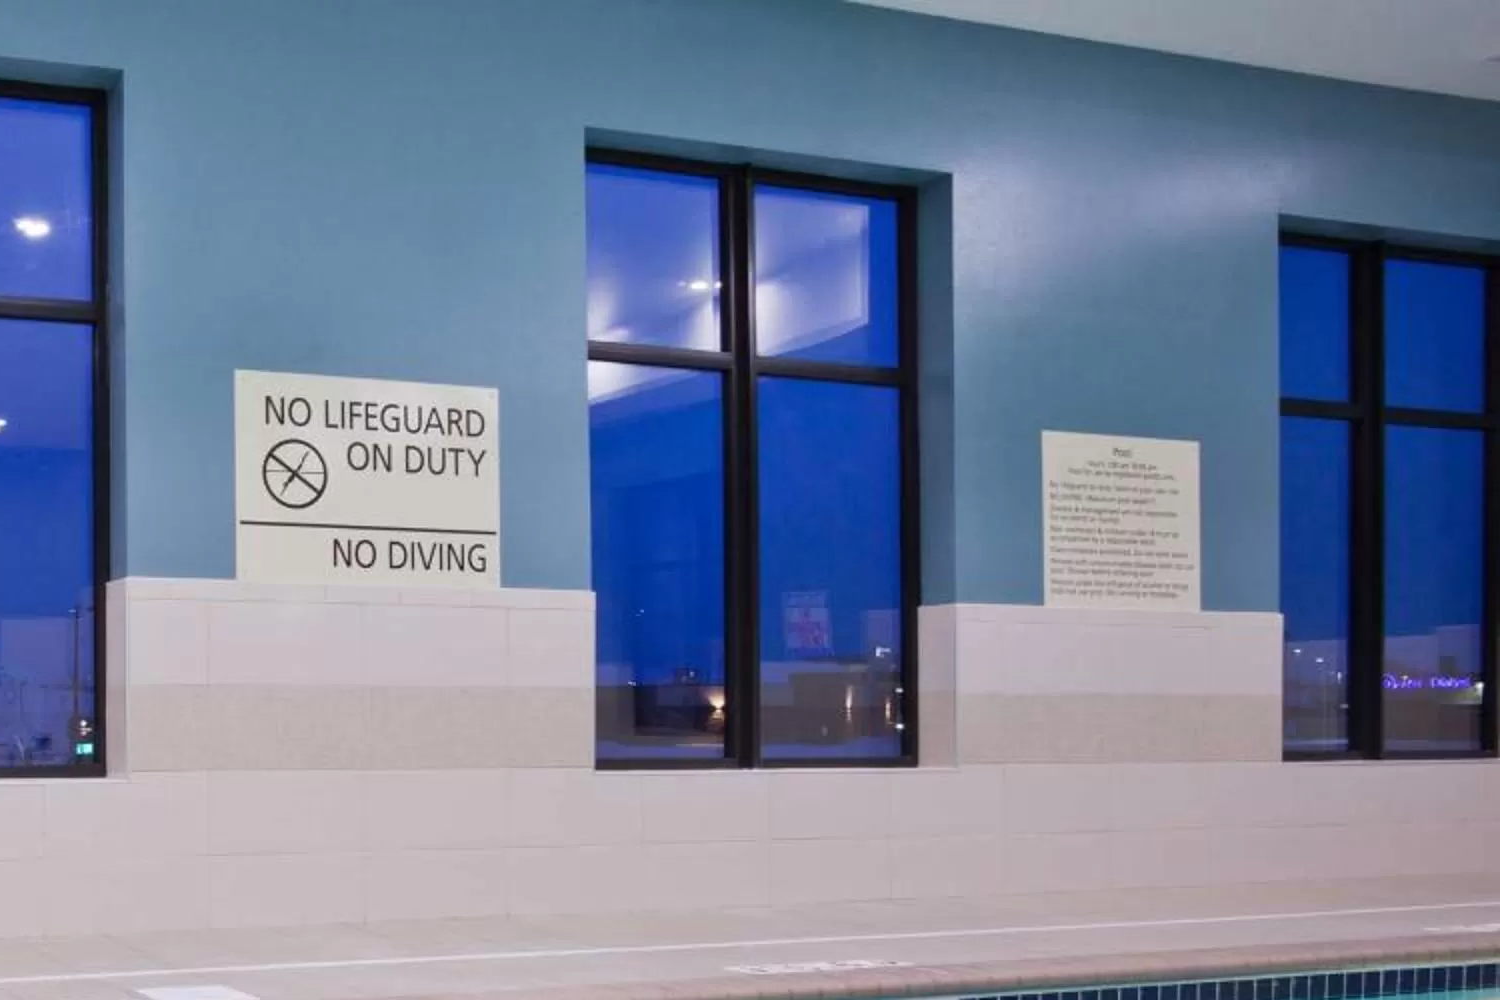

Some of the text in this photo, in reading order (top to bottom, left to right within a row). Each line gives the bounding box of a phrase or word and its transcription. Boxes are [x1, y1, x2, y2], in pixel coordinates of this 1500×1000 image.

[264, 395, 486, 438] NO LIFEGUARD
[347, 441, 487, 477] ON DUTY
[333, 538, 487, 573] NO DIVING
